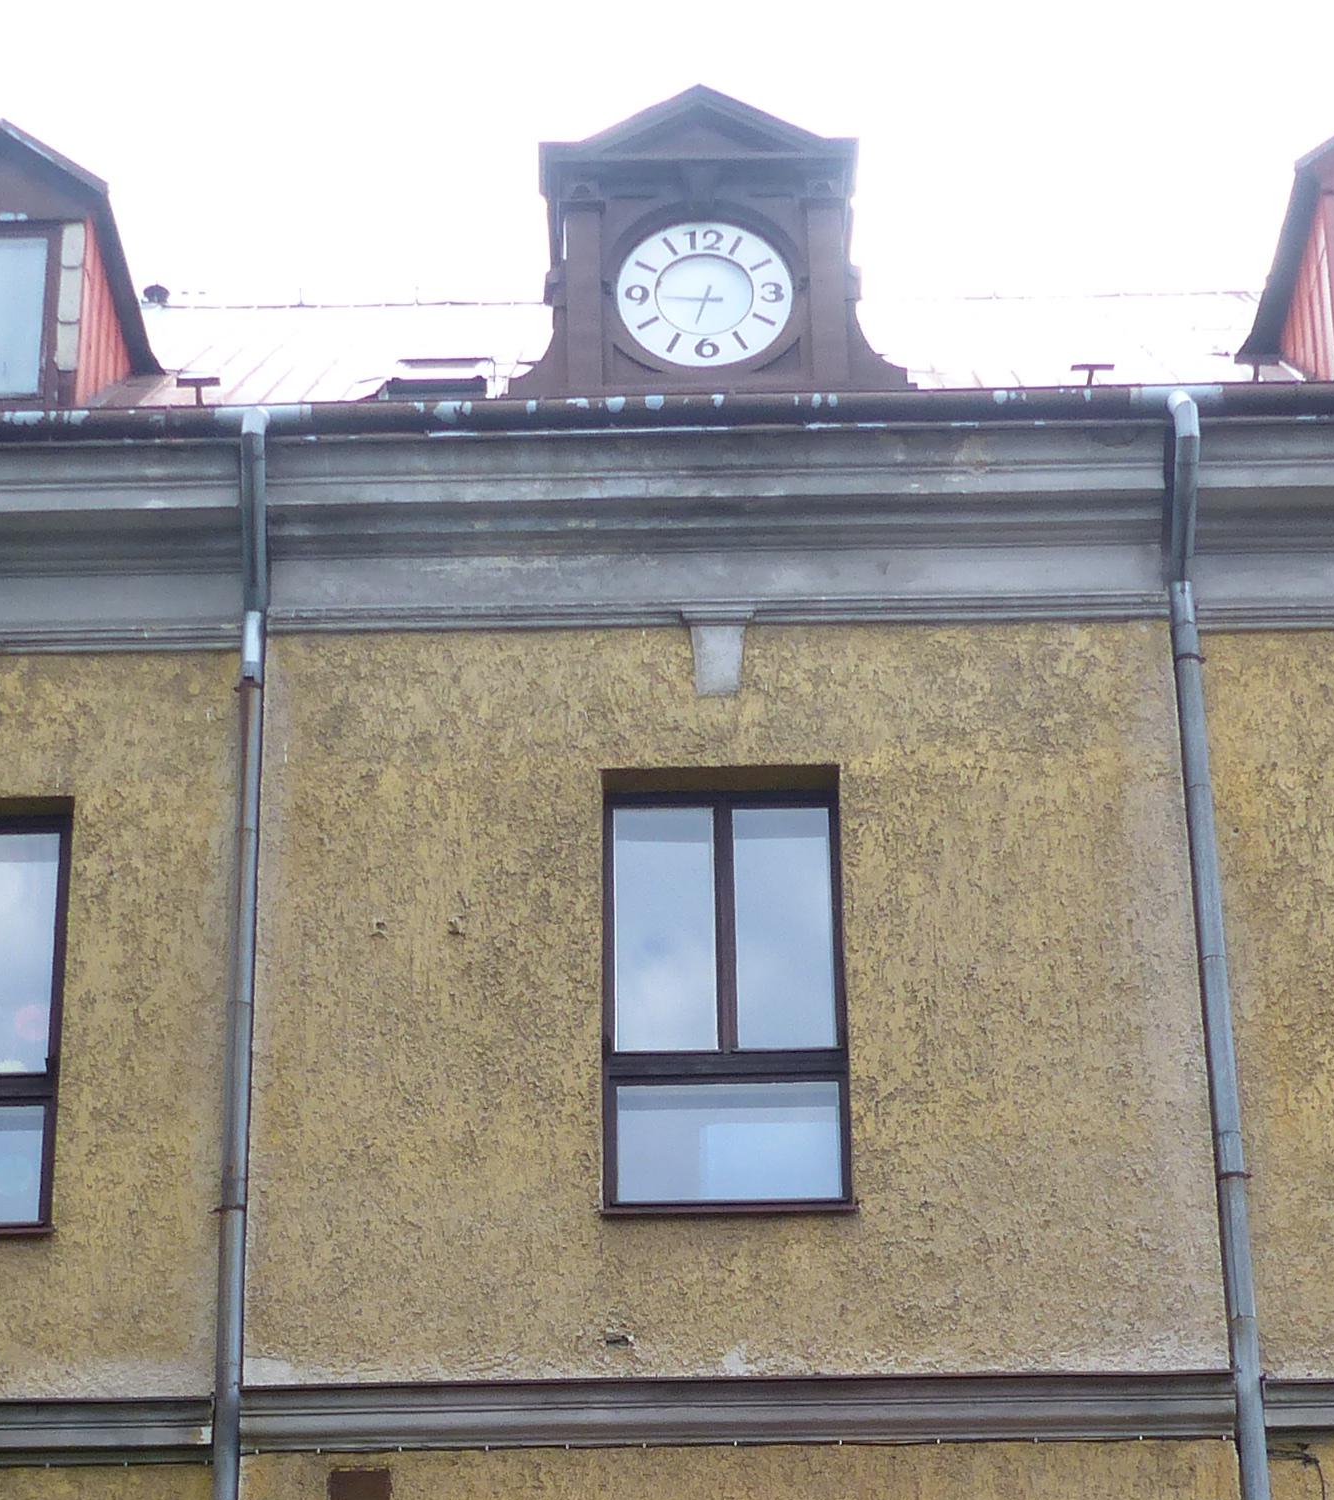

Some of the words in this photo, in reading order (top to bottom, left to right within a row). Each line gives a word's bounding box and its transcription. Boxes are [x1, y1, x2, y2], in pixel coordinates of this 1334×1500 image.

[683, 229, 724, 251] 12
[624, 284, 650, 306] 9
[760, 282, 785, 303] 3
[694, 337, 720, 359] 6
